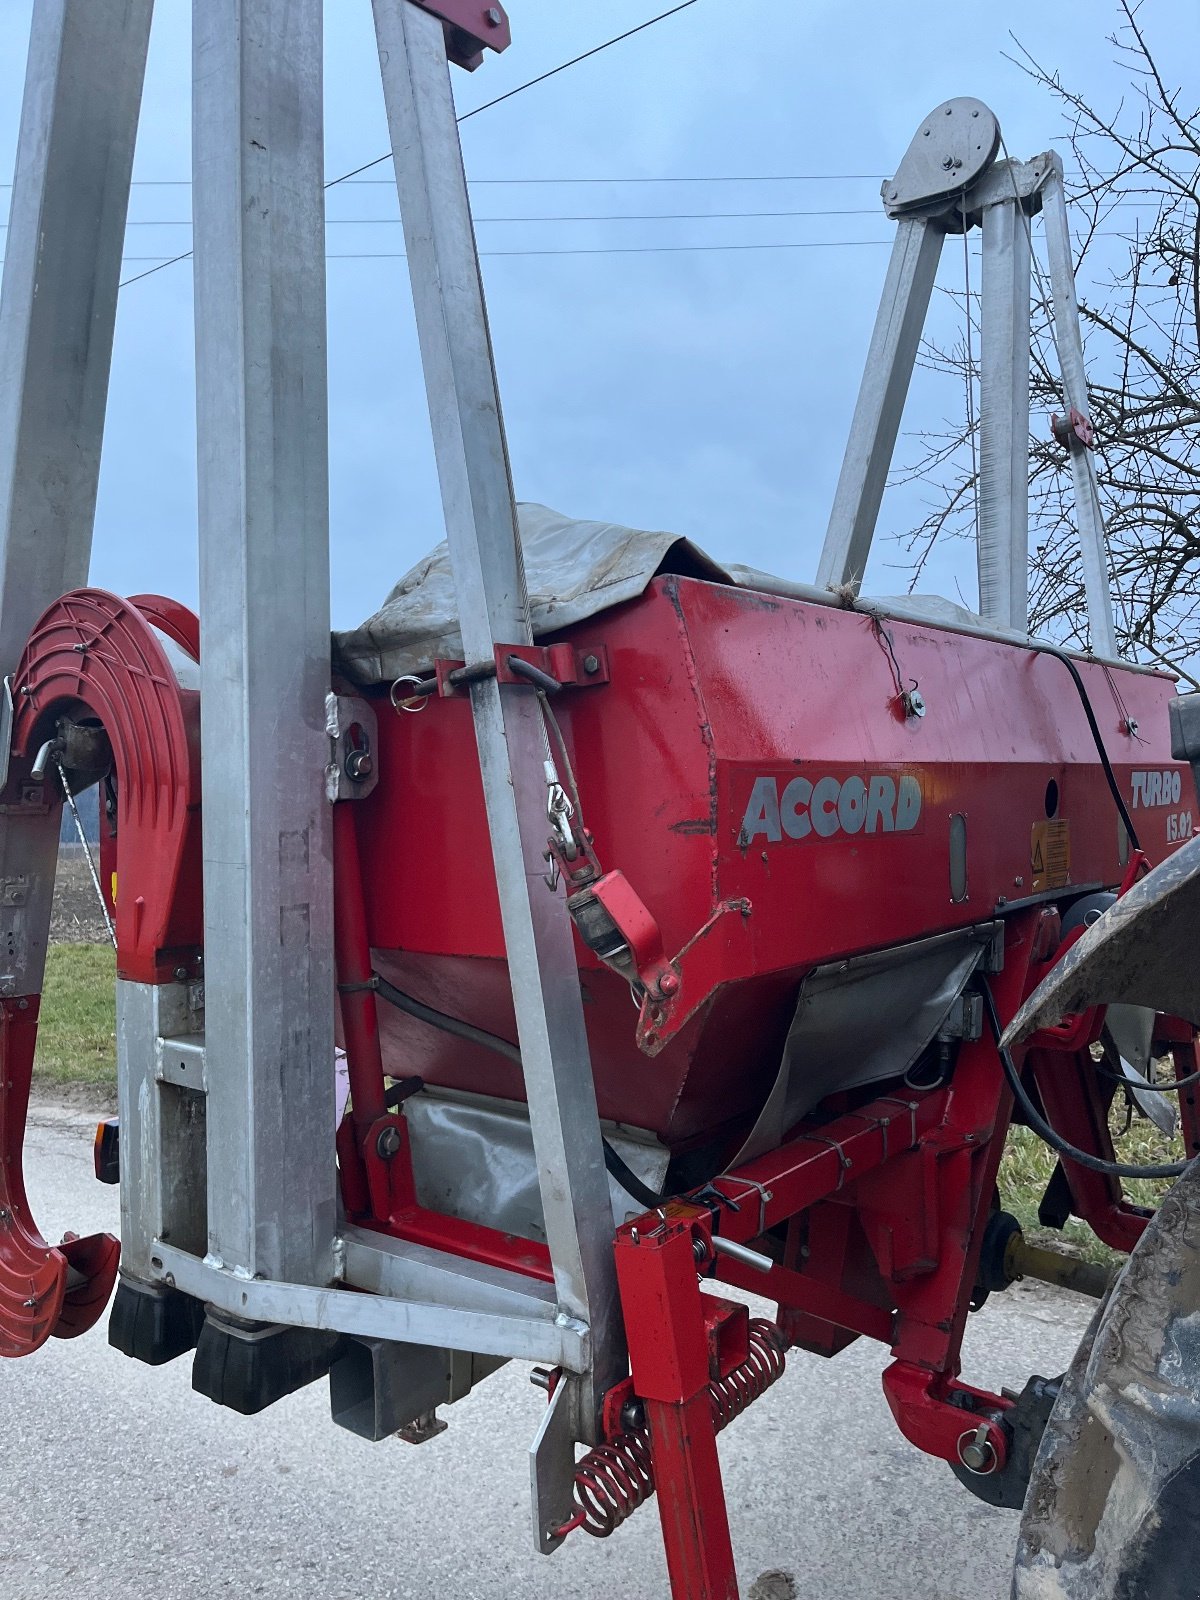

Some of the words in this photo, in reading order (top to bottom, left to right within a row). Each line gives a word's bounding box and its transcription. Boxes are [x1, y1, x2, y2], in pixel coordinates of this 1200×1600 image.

[1131, 771, 1181, 808] TURBO
[736, 775, 921, 845] ACCORD
[1167, 811, 1192, 841] 15.02
